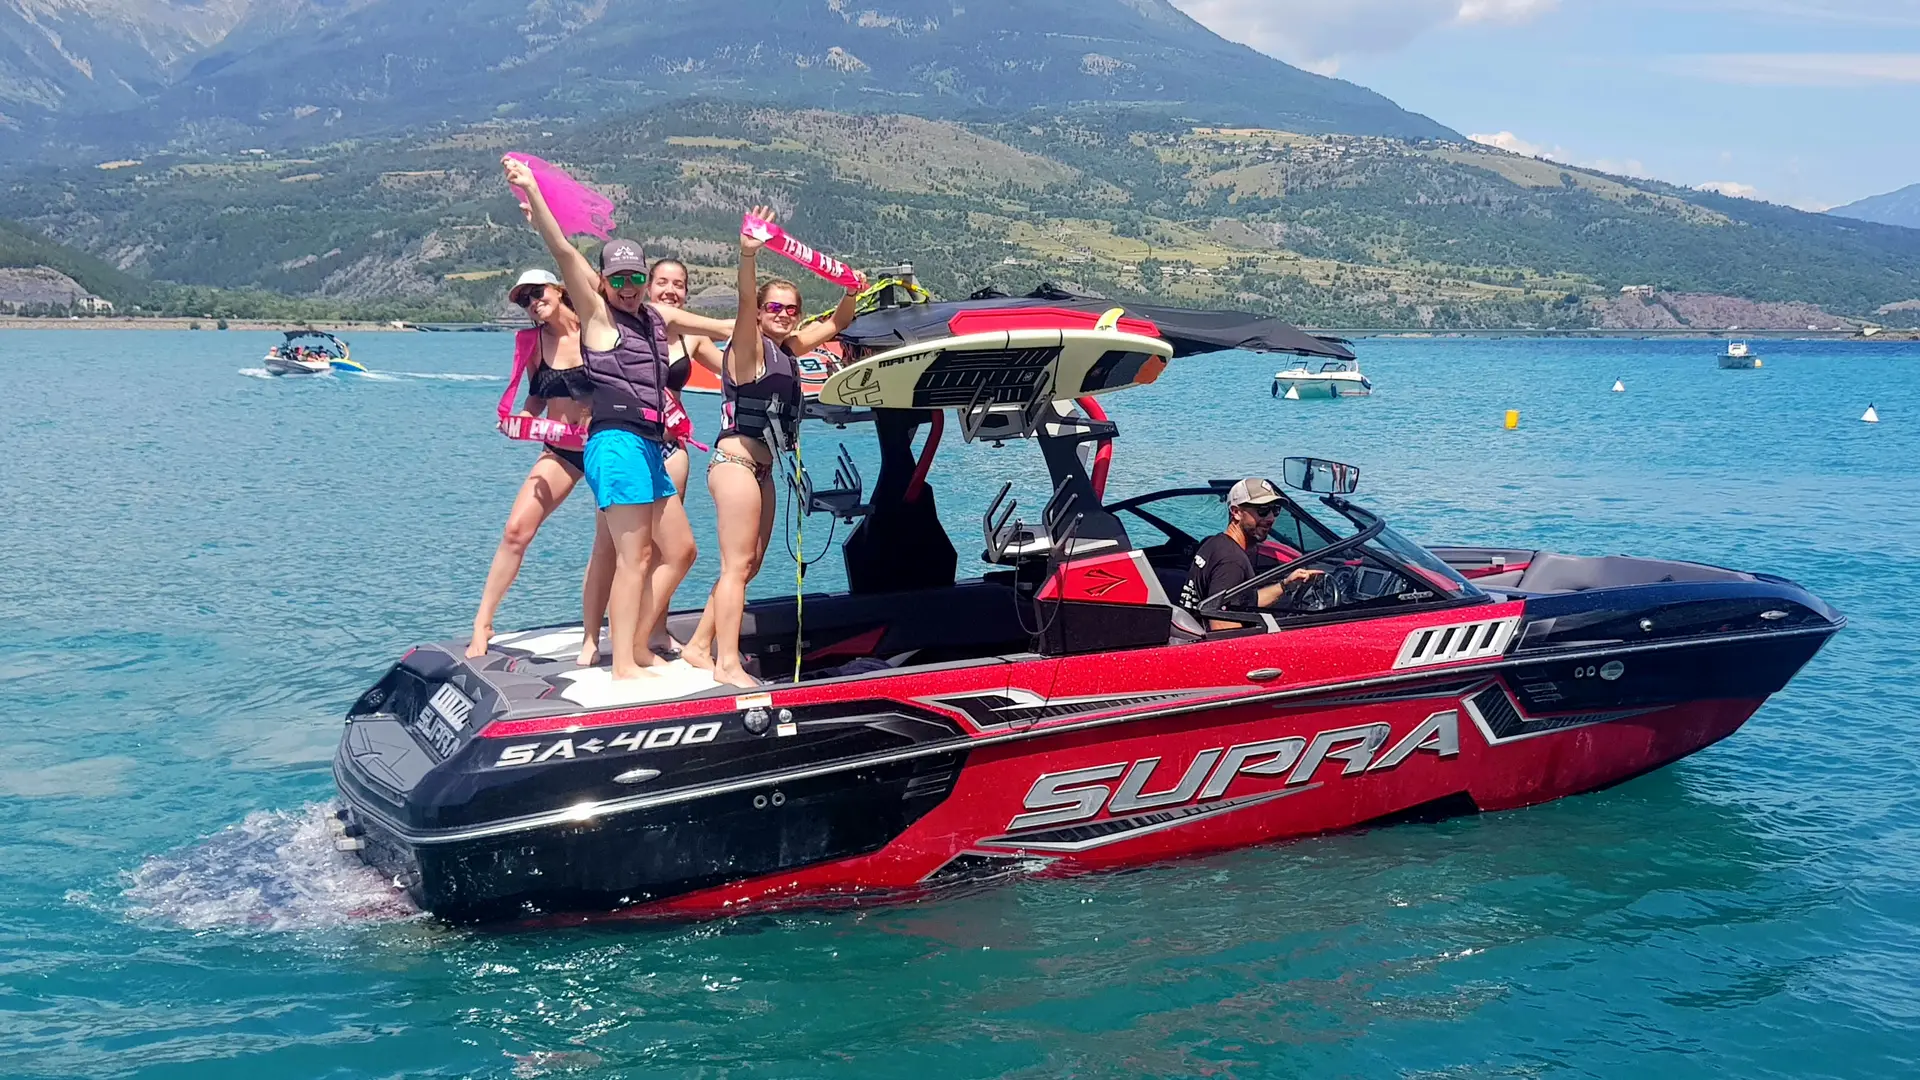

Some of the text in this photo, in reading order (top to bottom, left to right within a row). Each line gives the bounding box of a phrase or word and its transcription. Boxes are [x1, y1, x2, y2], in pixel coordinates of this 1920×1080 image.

[783, 234, 813, 264] TEAM
[529, 418, 566, 442] EVJF
[1006, 708, 1460, 832] SUPRA
